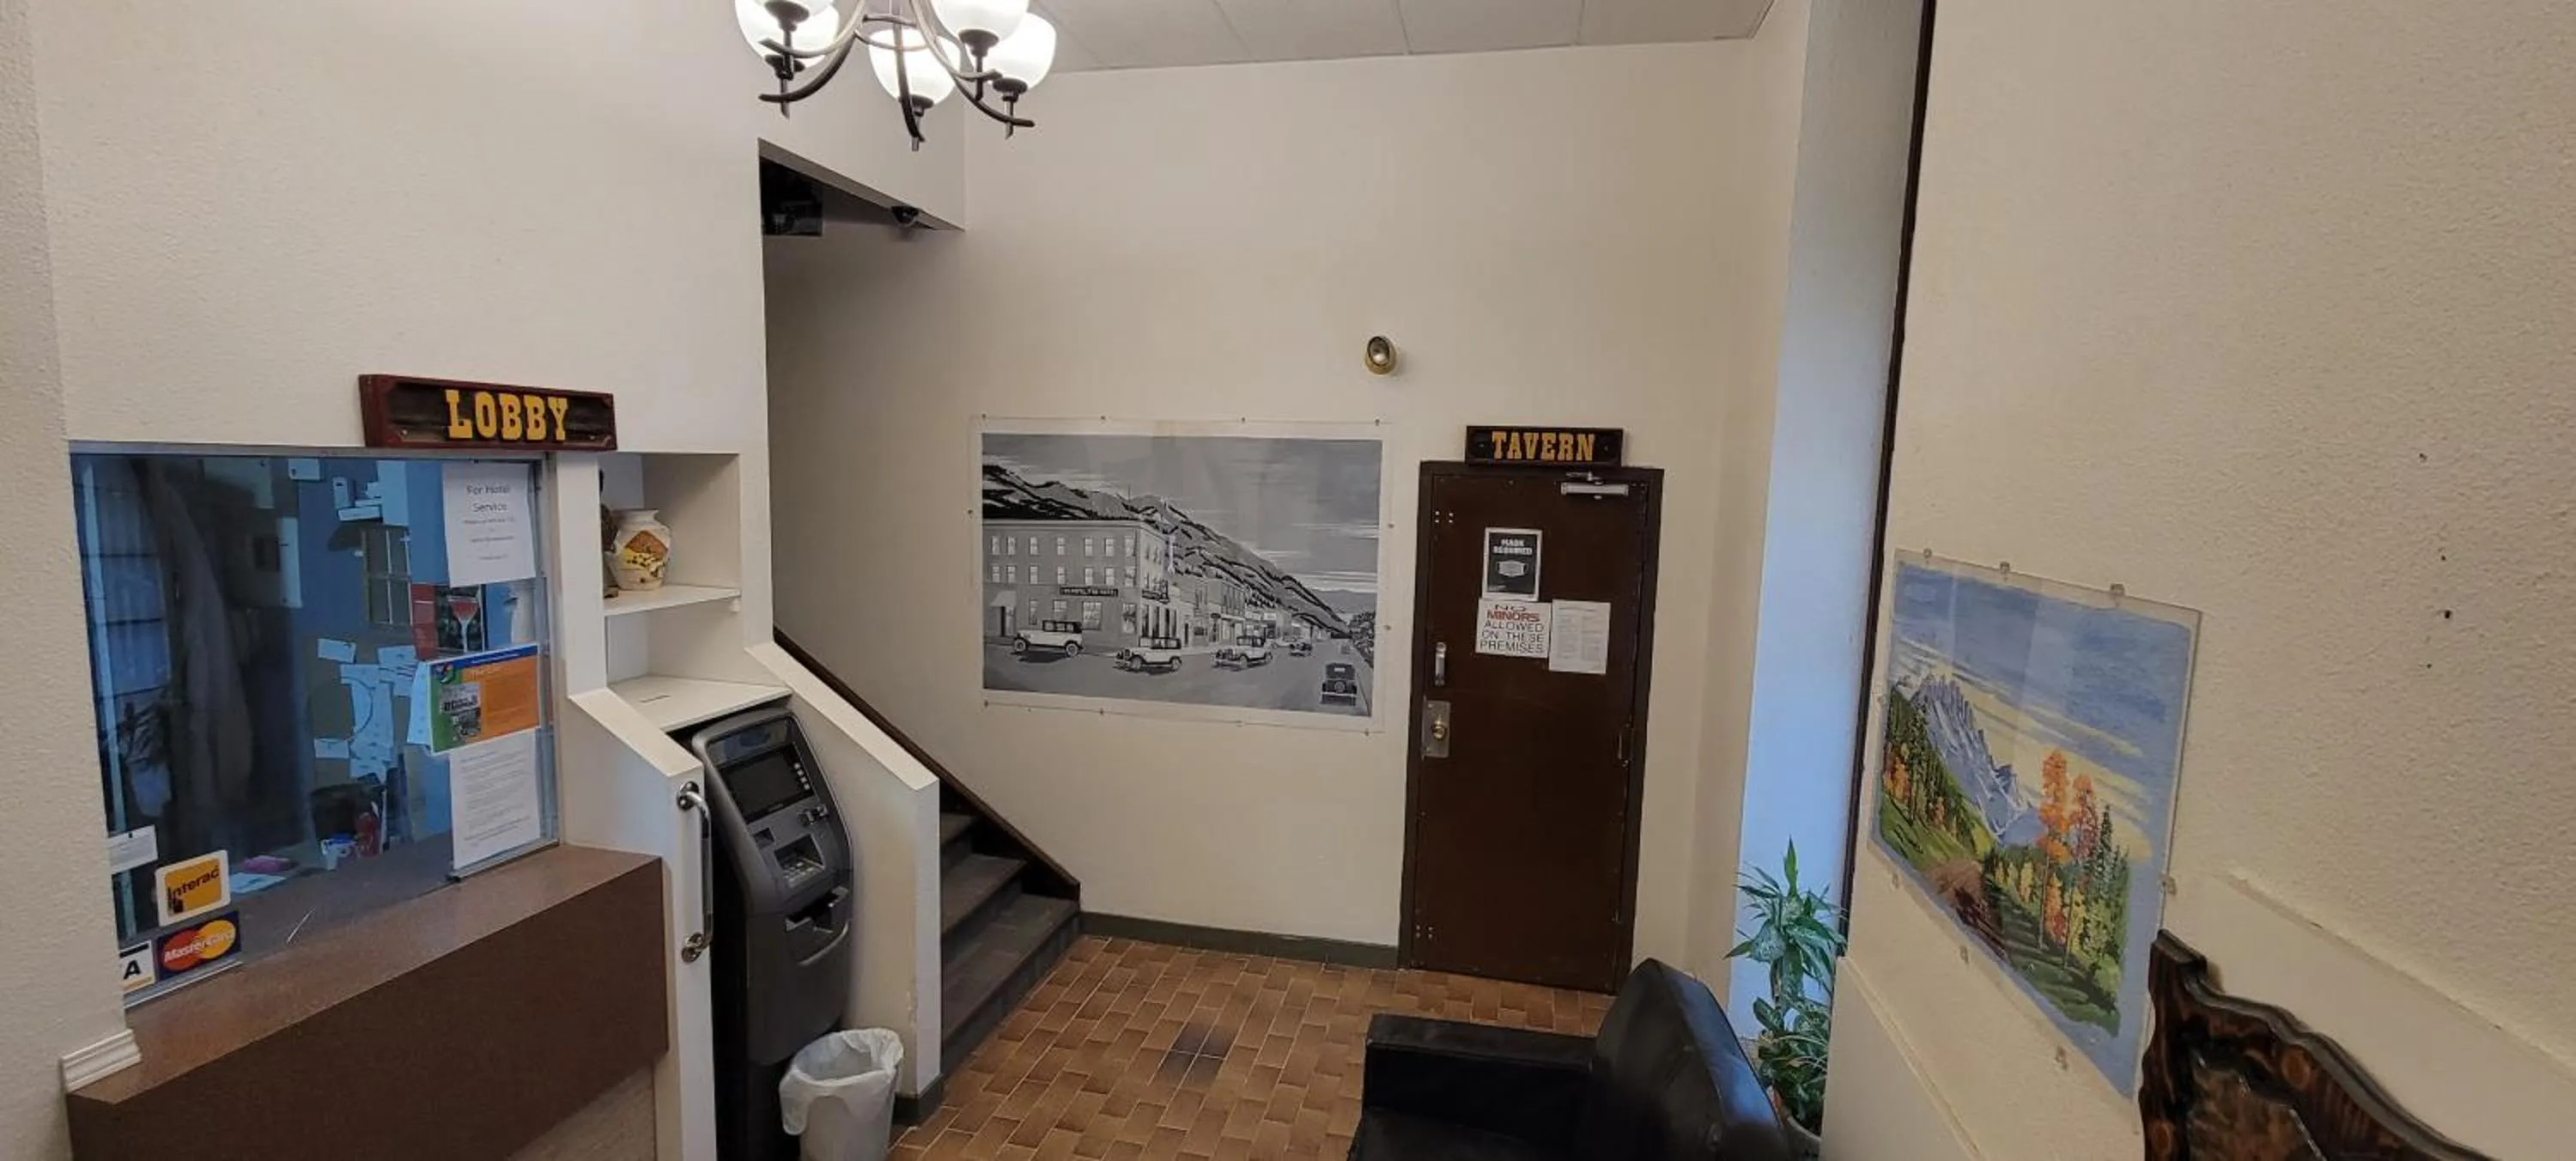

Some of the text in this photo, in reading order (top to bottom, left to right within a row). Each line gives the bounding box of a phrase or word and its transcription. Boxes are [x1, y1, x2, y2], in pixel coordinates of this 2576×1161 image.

[445, 389, 568, 441] LOBBY
[1492, 431, 1595, 461] TAVERN
[466, 484, 483, 495] For
[1500, 538, 1526, 547] MASK
[1486, 610, 1540, 623] MINORS
[1484, 619, 1545, 633] ALLOWED
[1481, 629, 1545, 643] ON THESE
[1479, 639, 1545, 654] PREMISES
[167, 866, 221, 901] Interac
